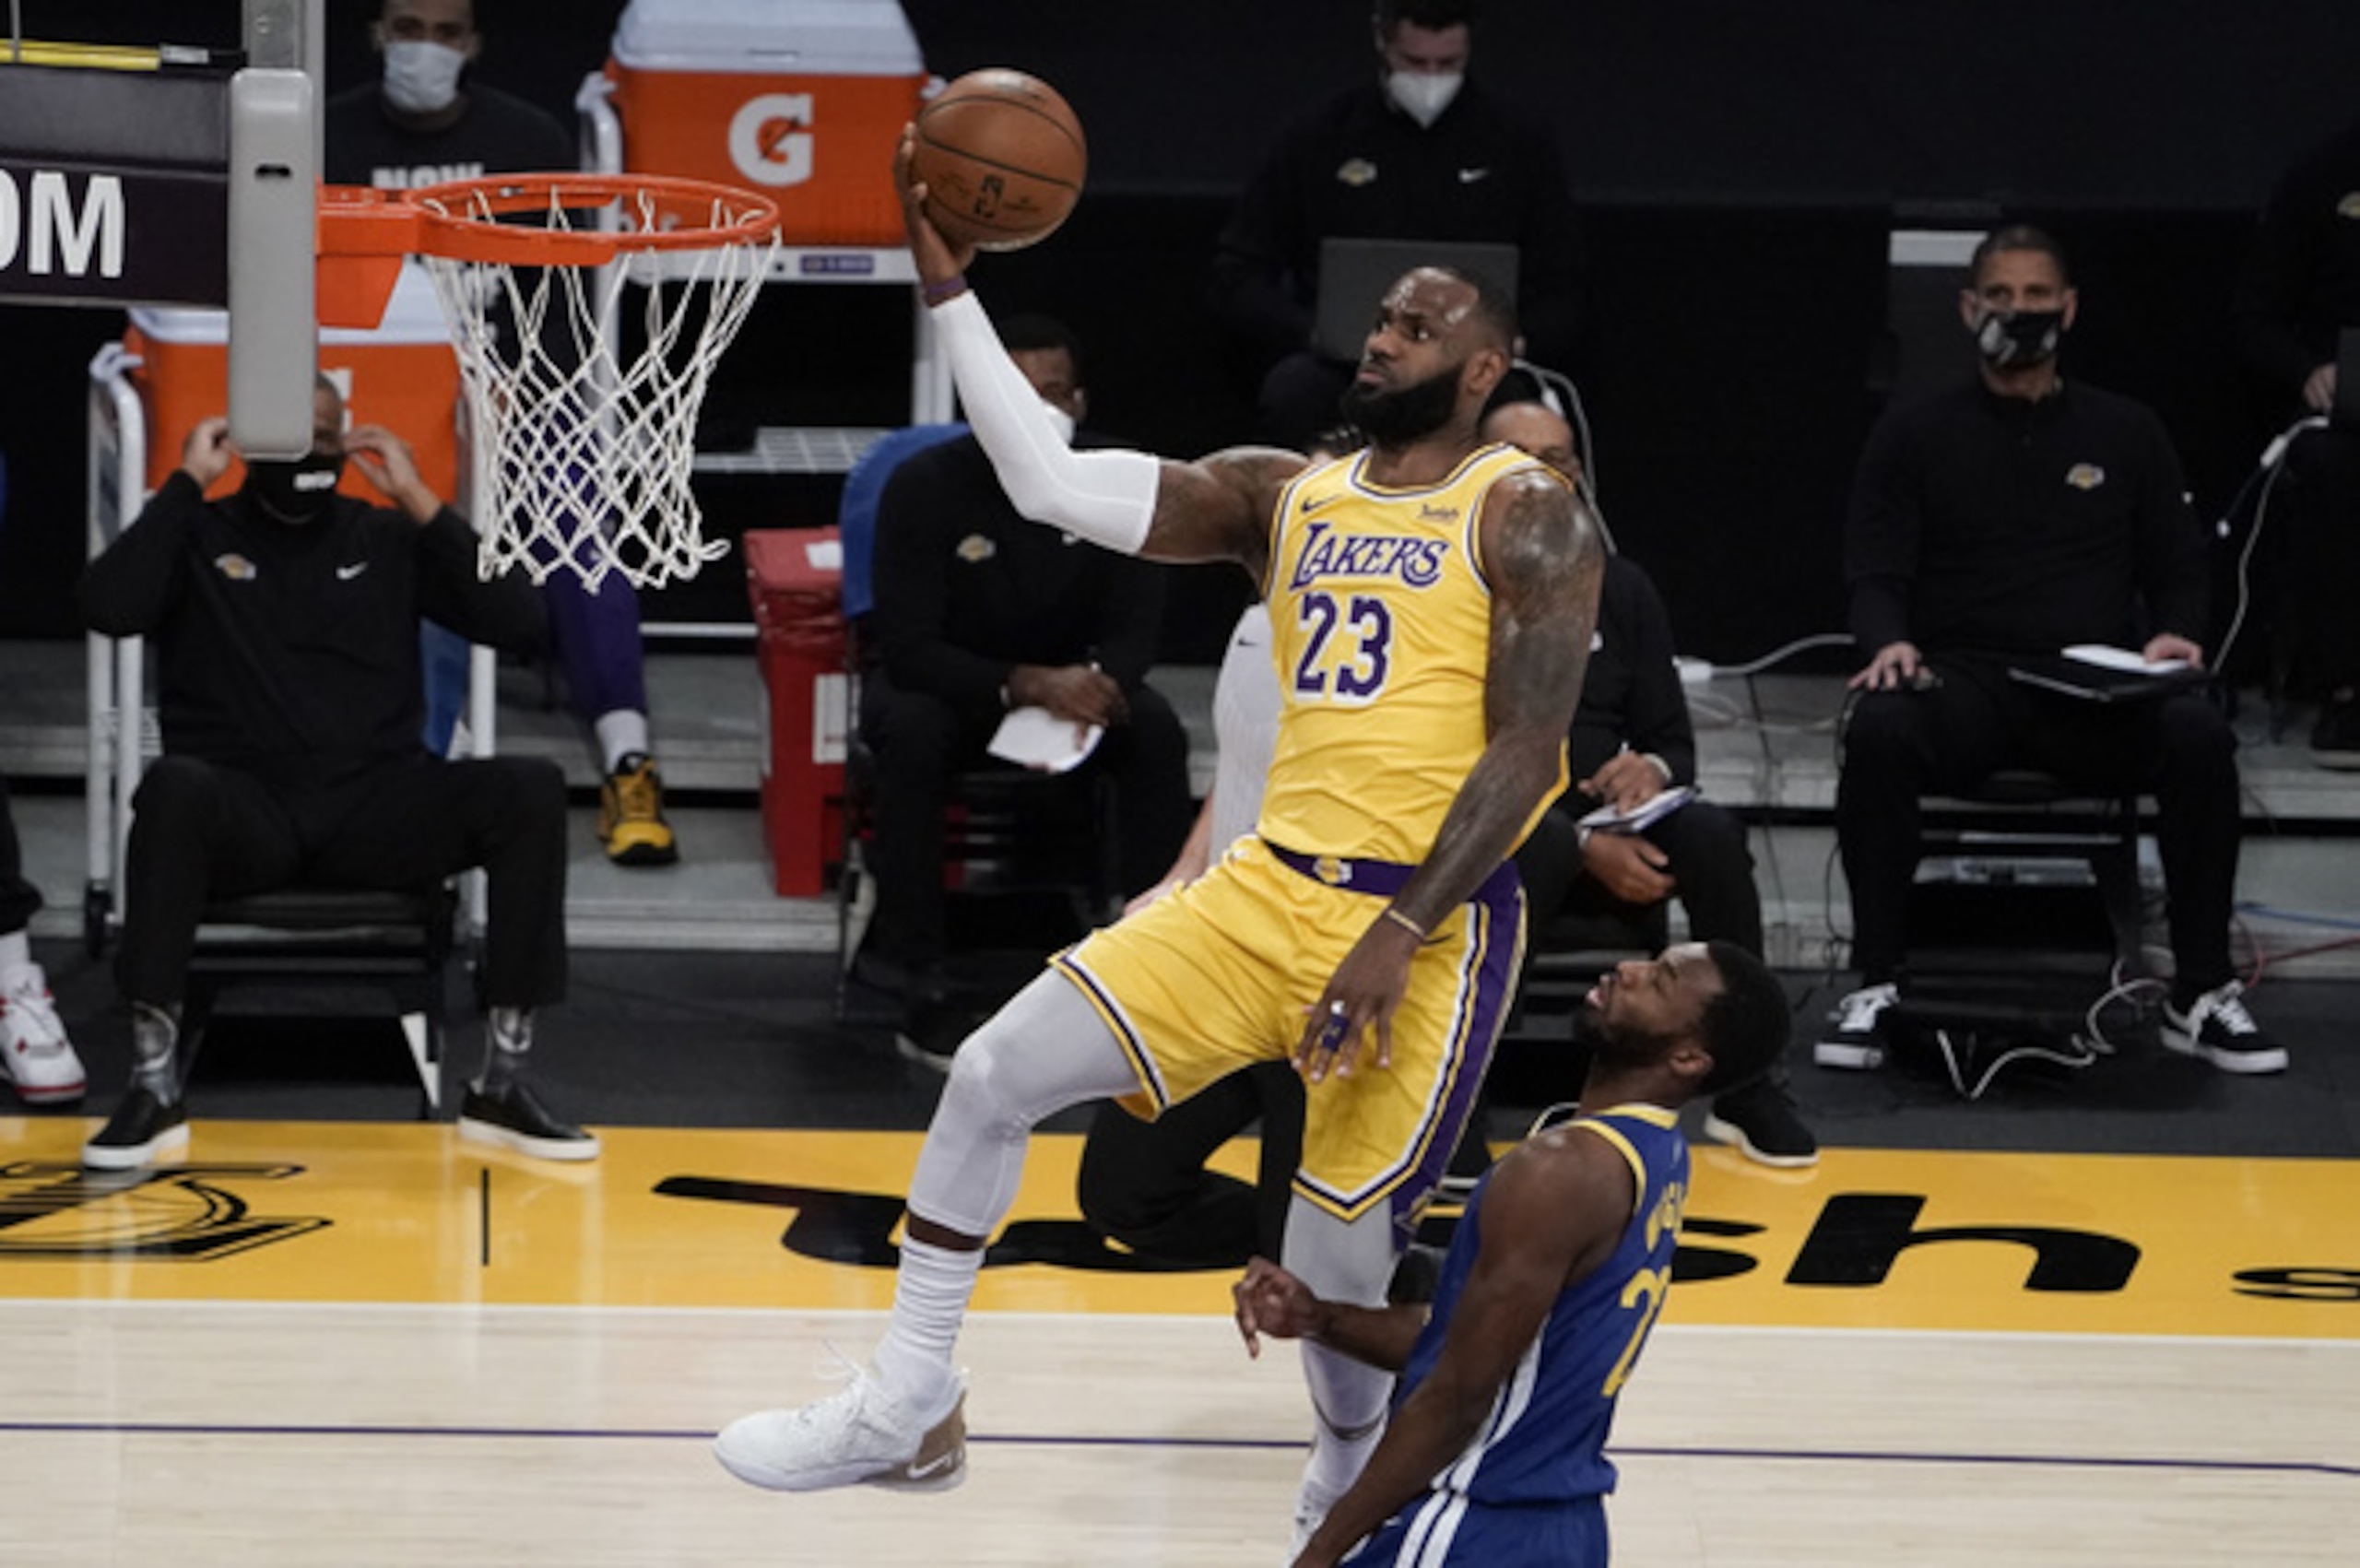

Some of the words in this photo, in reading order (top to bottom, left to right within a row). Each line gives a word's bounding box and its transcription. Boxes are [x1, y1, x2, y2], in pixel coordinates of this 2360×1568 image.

[728, 93, 814, 187] G
[1289, 522, 1451, 591] LAKERS
[1294, 591, 1393, 704] 23
